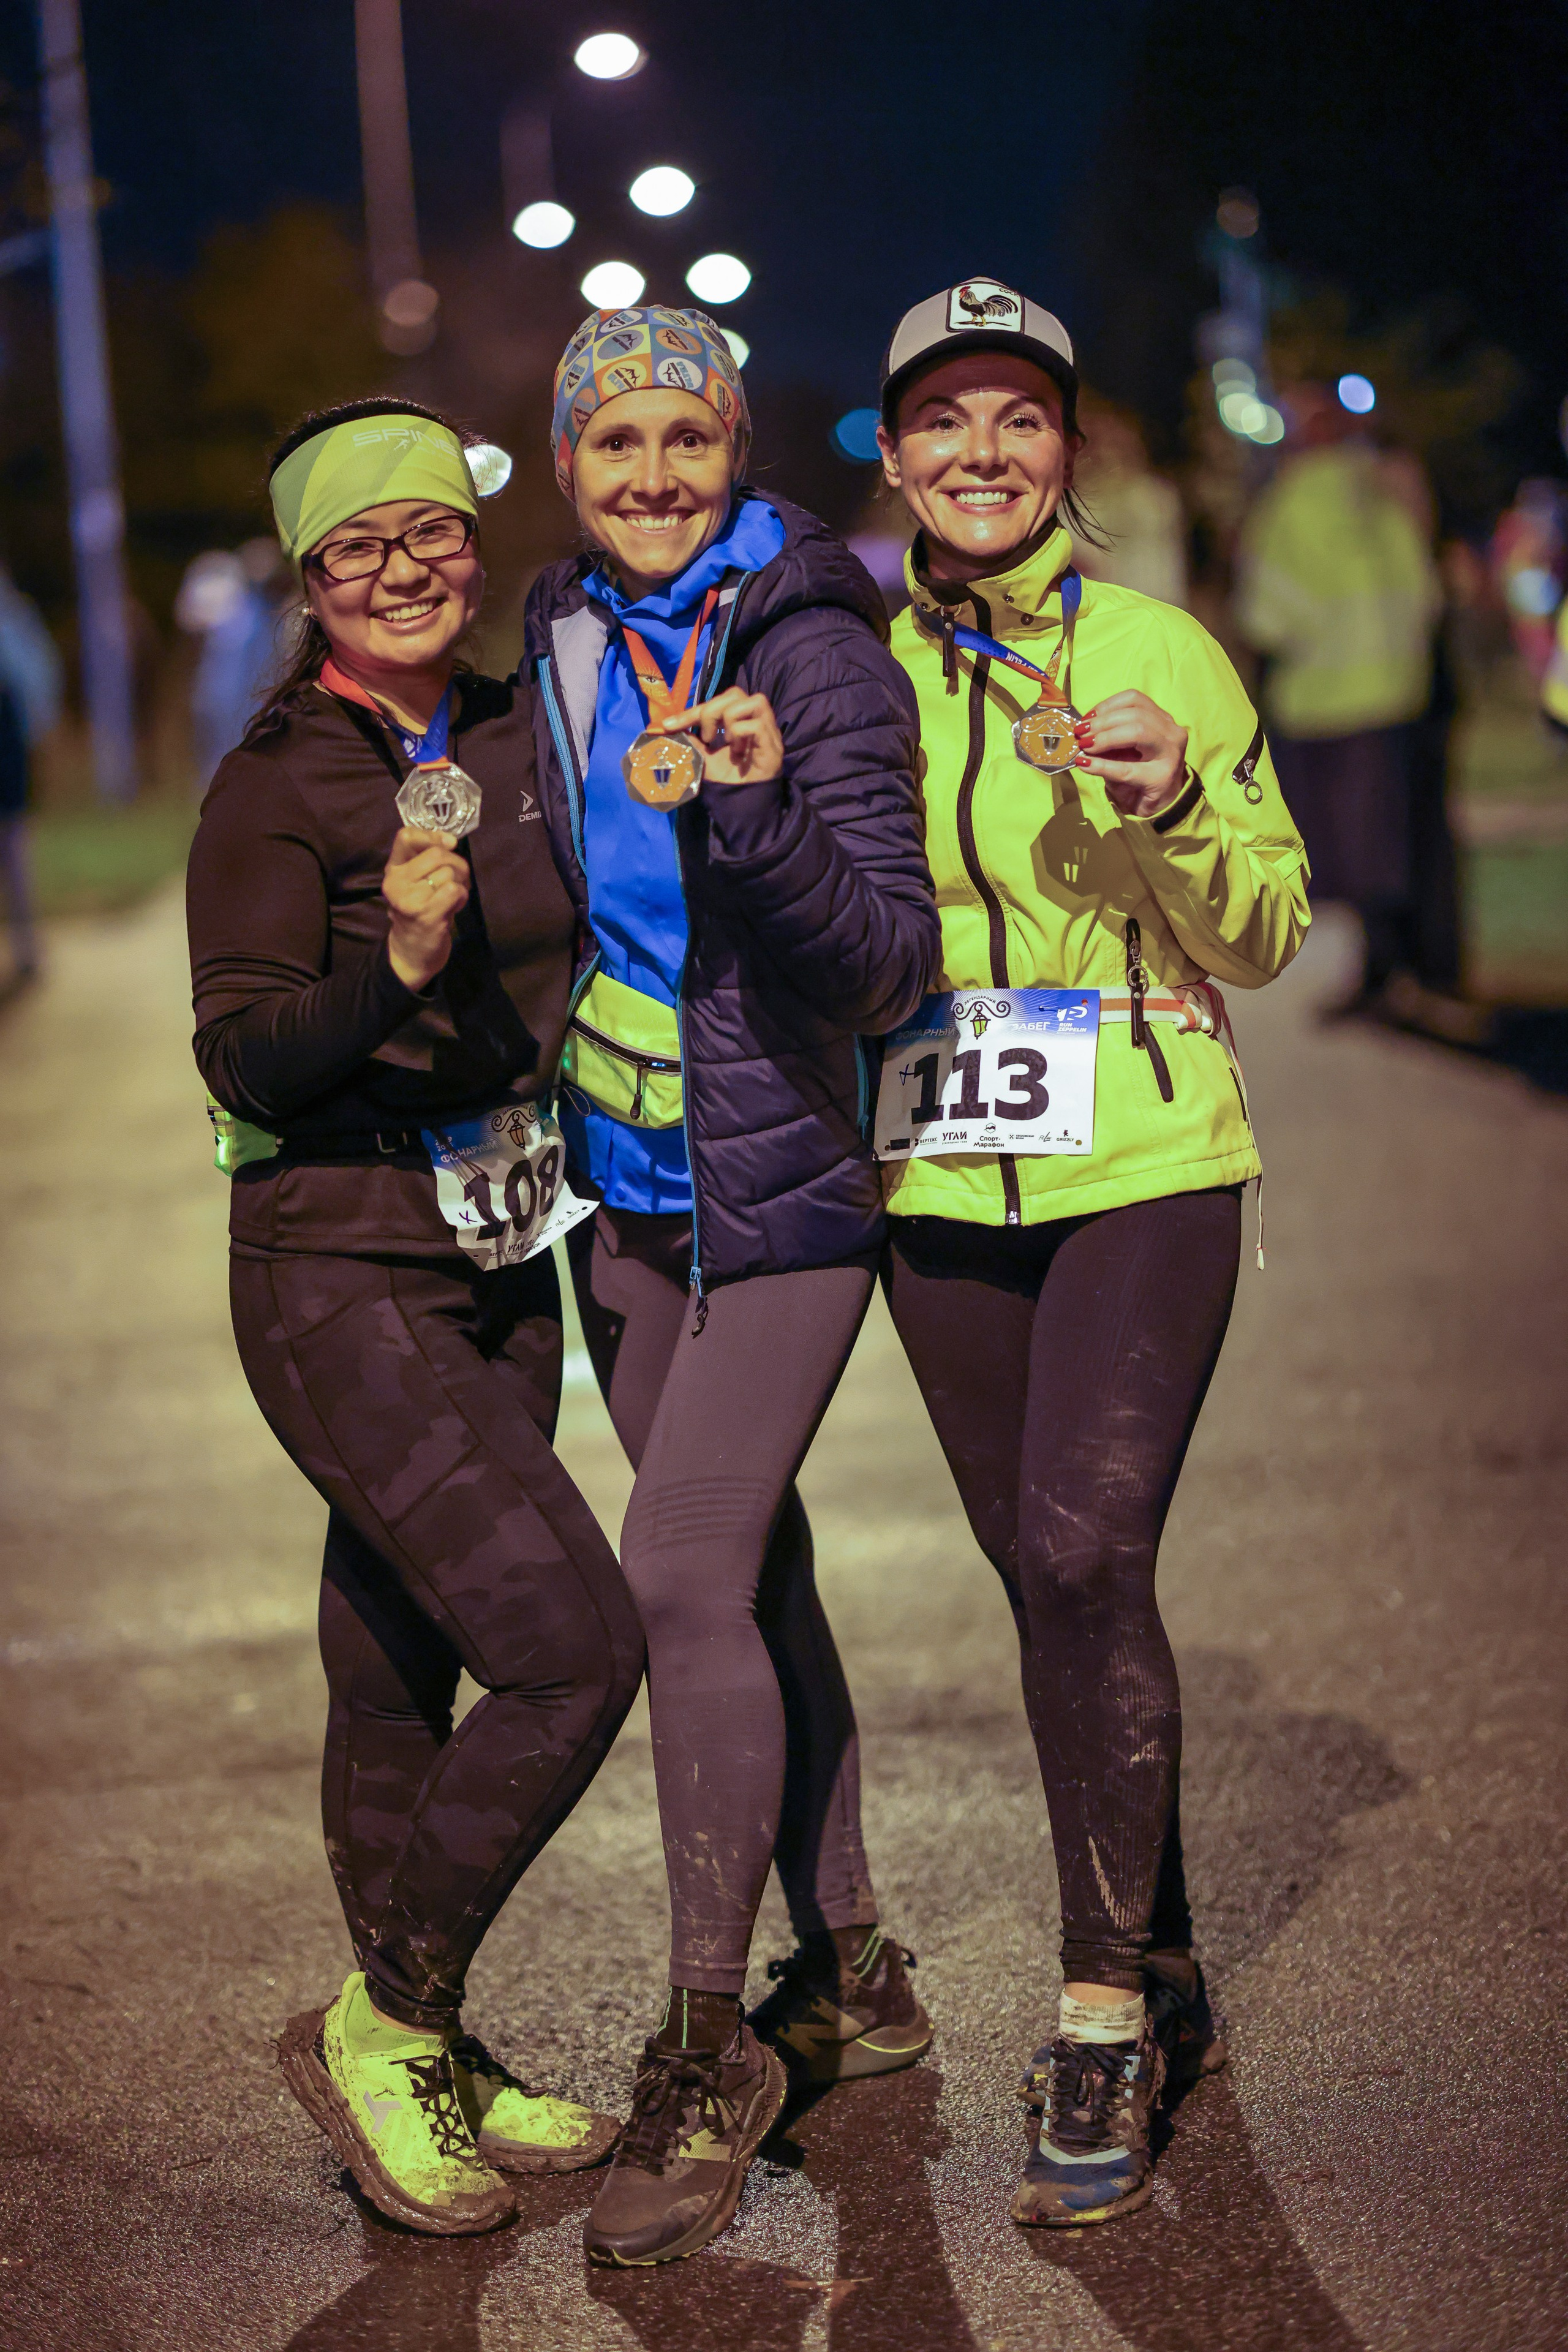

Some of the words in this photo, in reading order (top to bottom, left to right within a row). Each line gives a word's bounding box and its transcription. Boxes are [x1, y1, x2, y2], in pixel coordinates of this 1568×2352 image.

[352, 428, 459, 459] SPINE
[964, 995, 997, 1005] ЛЕГЕНДАРНЫЙ
[895, 1027, 956, 1041] ФОНАРНЫЙ
[1012, 1022, 1050, 1031] ЗАБЕГ
[911, 1047, 1049, 1125] 113
[464, 1145, 559, 1242] 108
